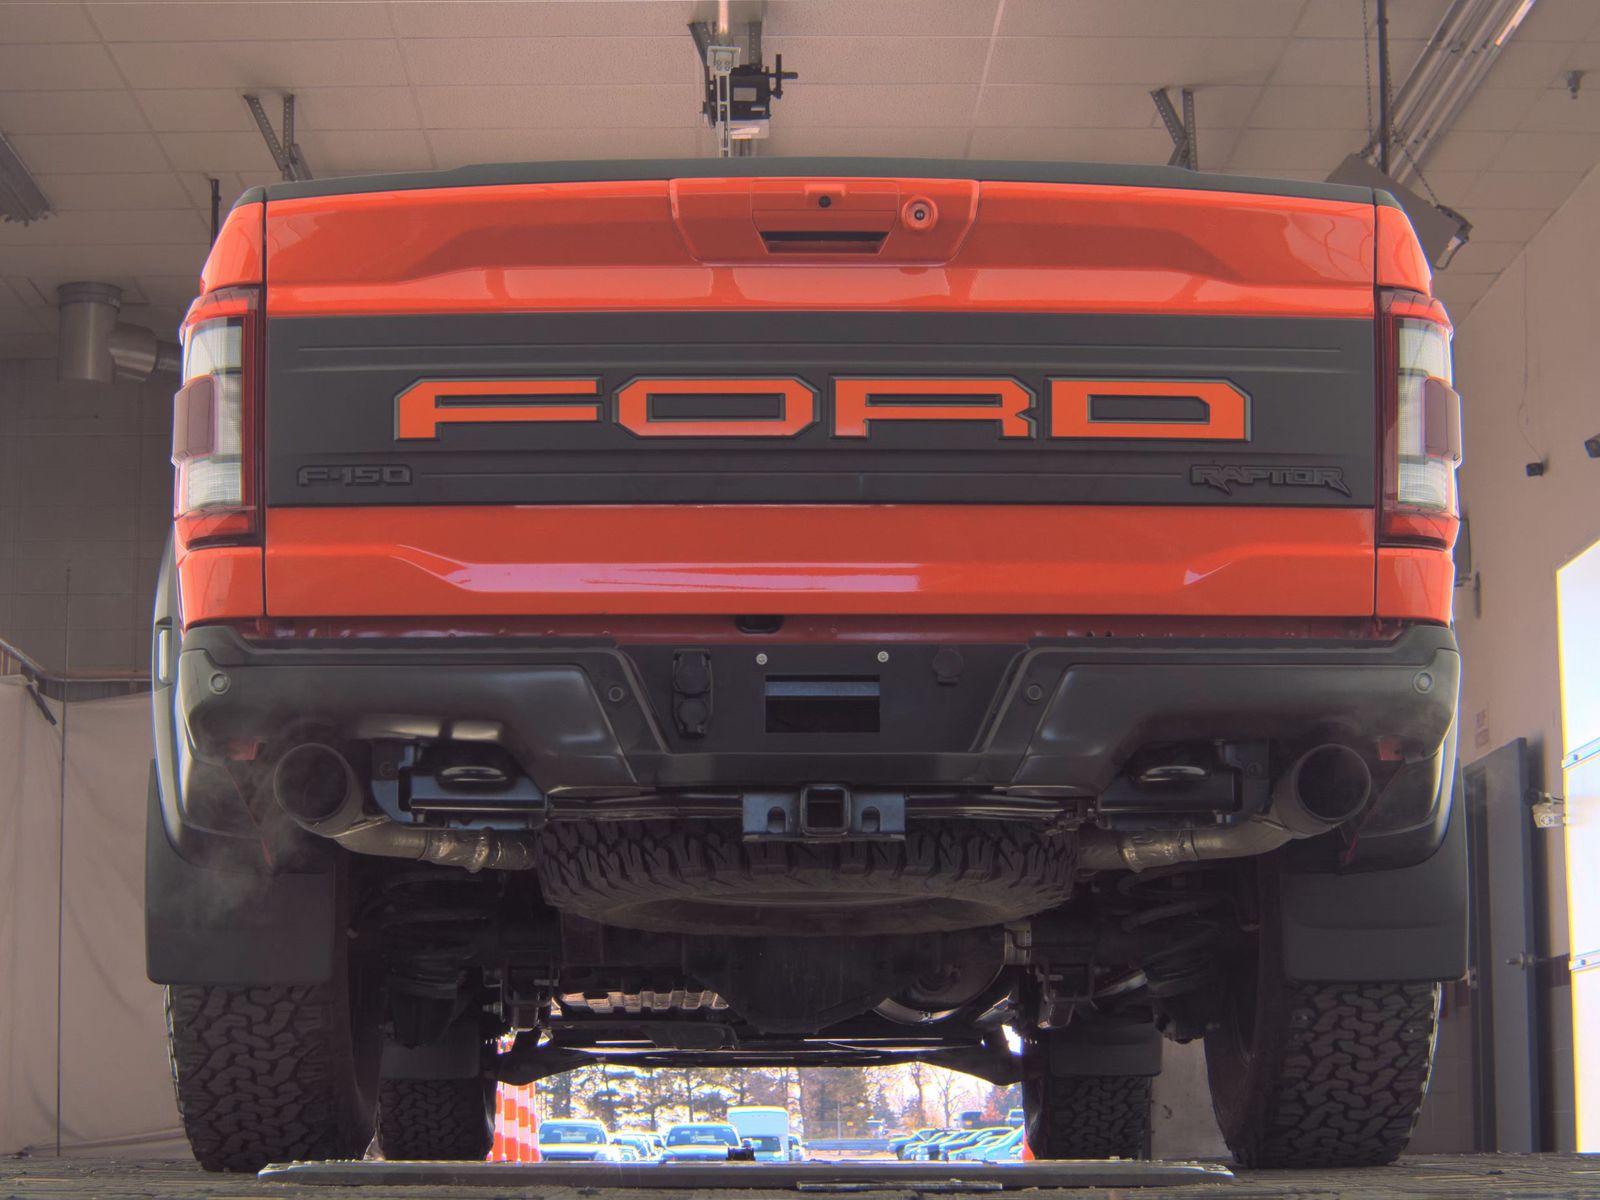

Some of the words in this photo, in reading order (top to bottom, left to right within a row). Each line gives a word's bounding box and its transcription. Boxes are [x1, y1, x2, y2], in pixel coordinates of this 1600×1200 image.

[394, 375, 1252, 441] FORD
[297, 465, 412, 486] F-150
[1191, 465, 1352, 497] RAPTOR
